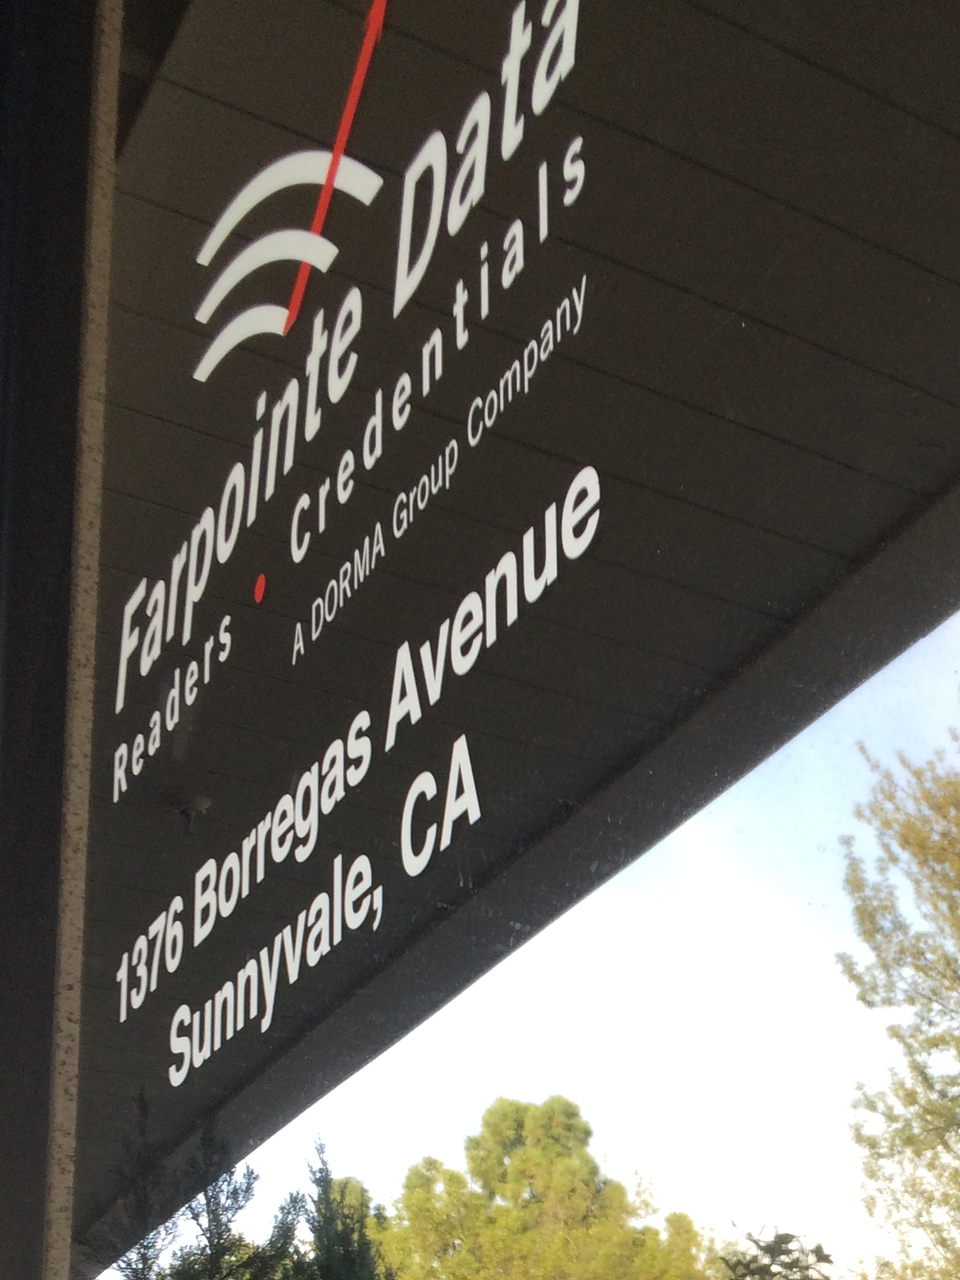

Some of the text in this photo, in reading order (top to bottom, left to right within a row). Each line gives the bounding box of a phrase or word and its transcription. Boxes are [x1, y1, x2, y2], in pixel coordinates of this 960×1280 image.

[112, 136, 587, 804] Readers Credentials
[114, 0, 581, 715] Farpointe Data
[292, 274, 587, 666] A DORMA Group Company
[115, 465, 601, 1023] 1376 Borregas Avenue
[168, 733, 482, 1088] Sunnyvale, CA
